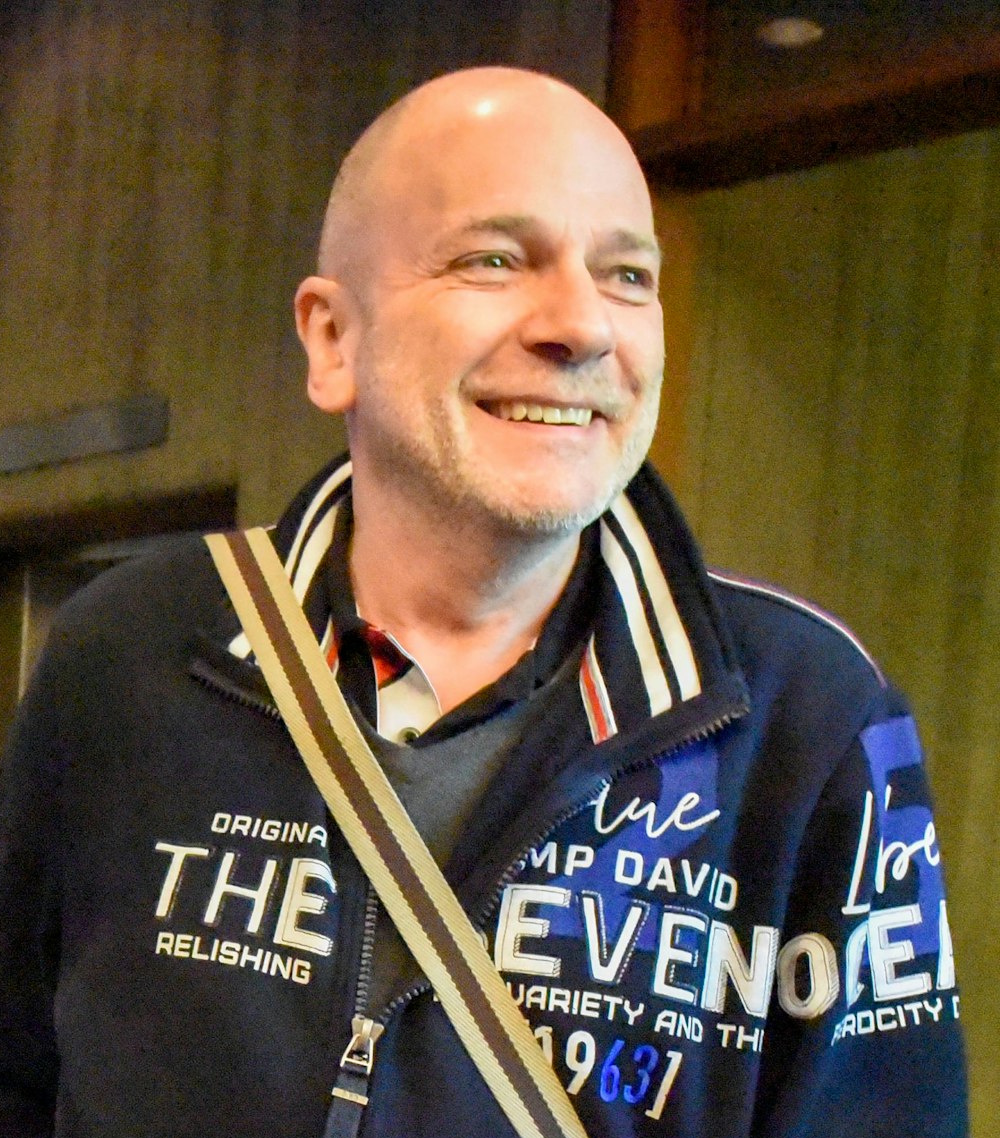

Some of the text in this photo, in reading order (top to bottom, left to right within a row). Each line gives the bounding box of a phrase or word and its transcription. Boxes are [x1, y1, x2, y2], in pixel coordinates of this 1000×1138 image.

[212, 813, 328, 847] ORIGINA
[154, 842, 337, 956] THE
[520, 842, 739, 911] MP DAVID
[155, 931, 312, 985] RELISHING
[493, 883, 780, 1019] EVEN
[654, 1009, 703, 1043] AND
